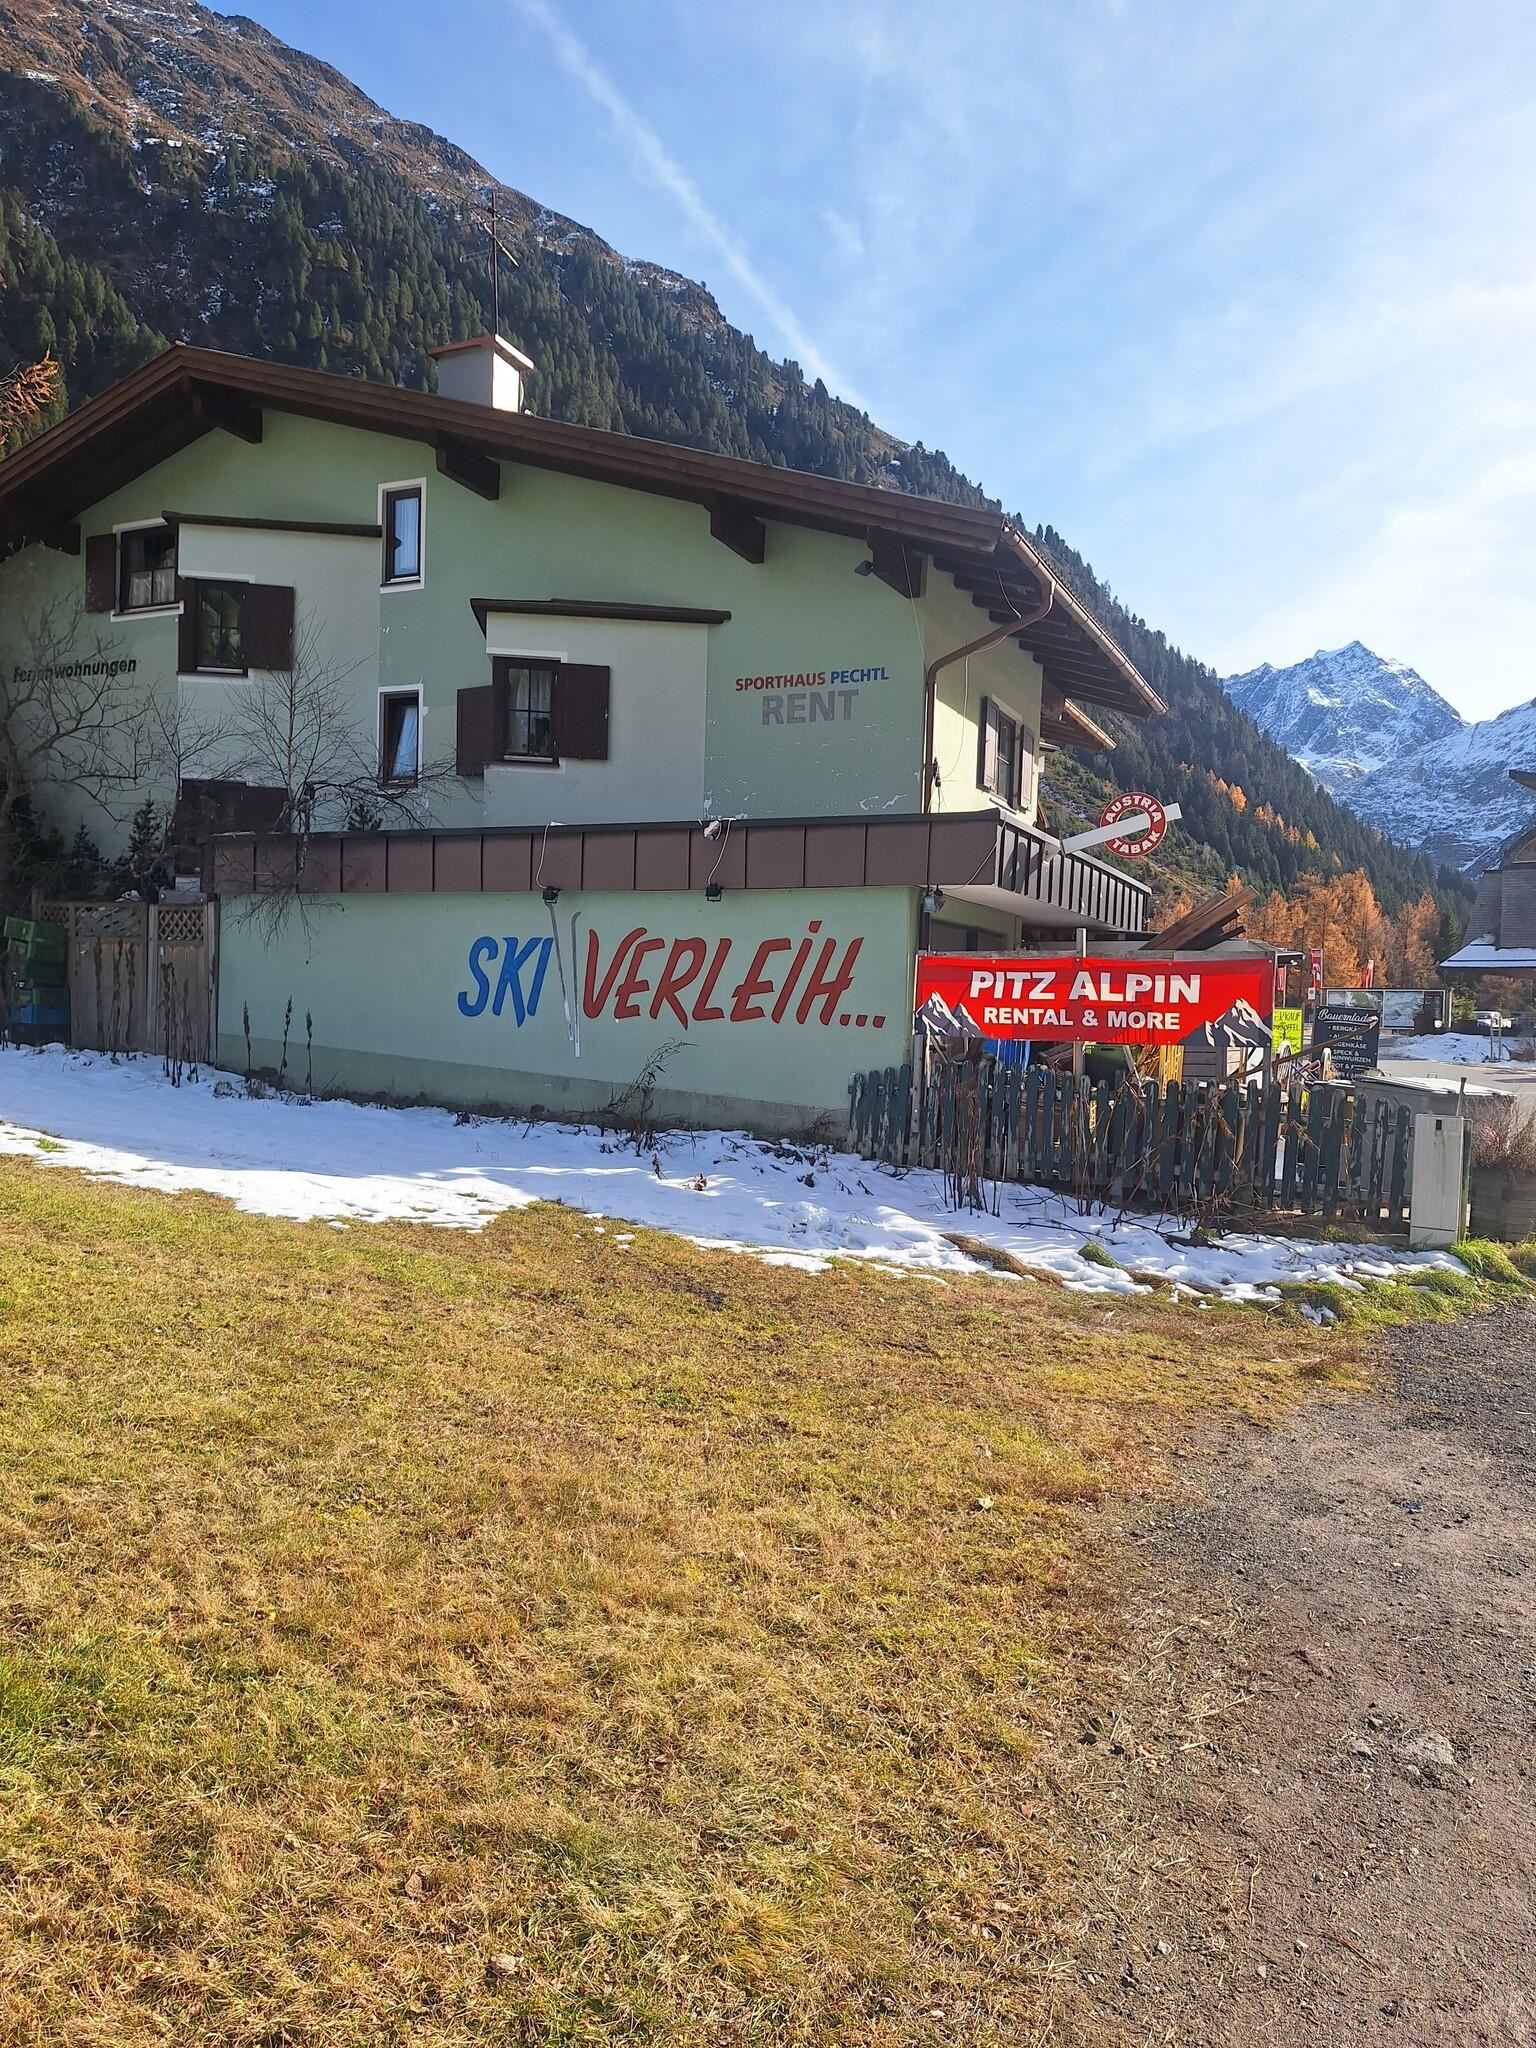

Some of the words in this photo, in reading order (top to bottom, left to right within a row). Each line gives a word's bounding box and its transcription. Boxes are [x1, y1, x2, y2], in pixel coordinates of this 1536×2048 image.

[735, 672, 826, 691] SPORTHAUS
[831, 667, 889, 685] PECHTL
[761, 689, 859, 726] RENT
[1105, 795, 1162, 823] AUSTRIA
[1112, 830, 1160, 854] TABAK
[457, 936, 554, 1028] SKI
[969, 970, 1056, 1000] PITZ
[1069, 971, 1201, 1003] ALPIN
[984, 1007, 1073, 1026] RENTAL
[1082, 1009, 1098, 1027] &
[1107, 1010, 1180, 1030] MORE
